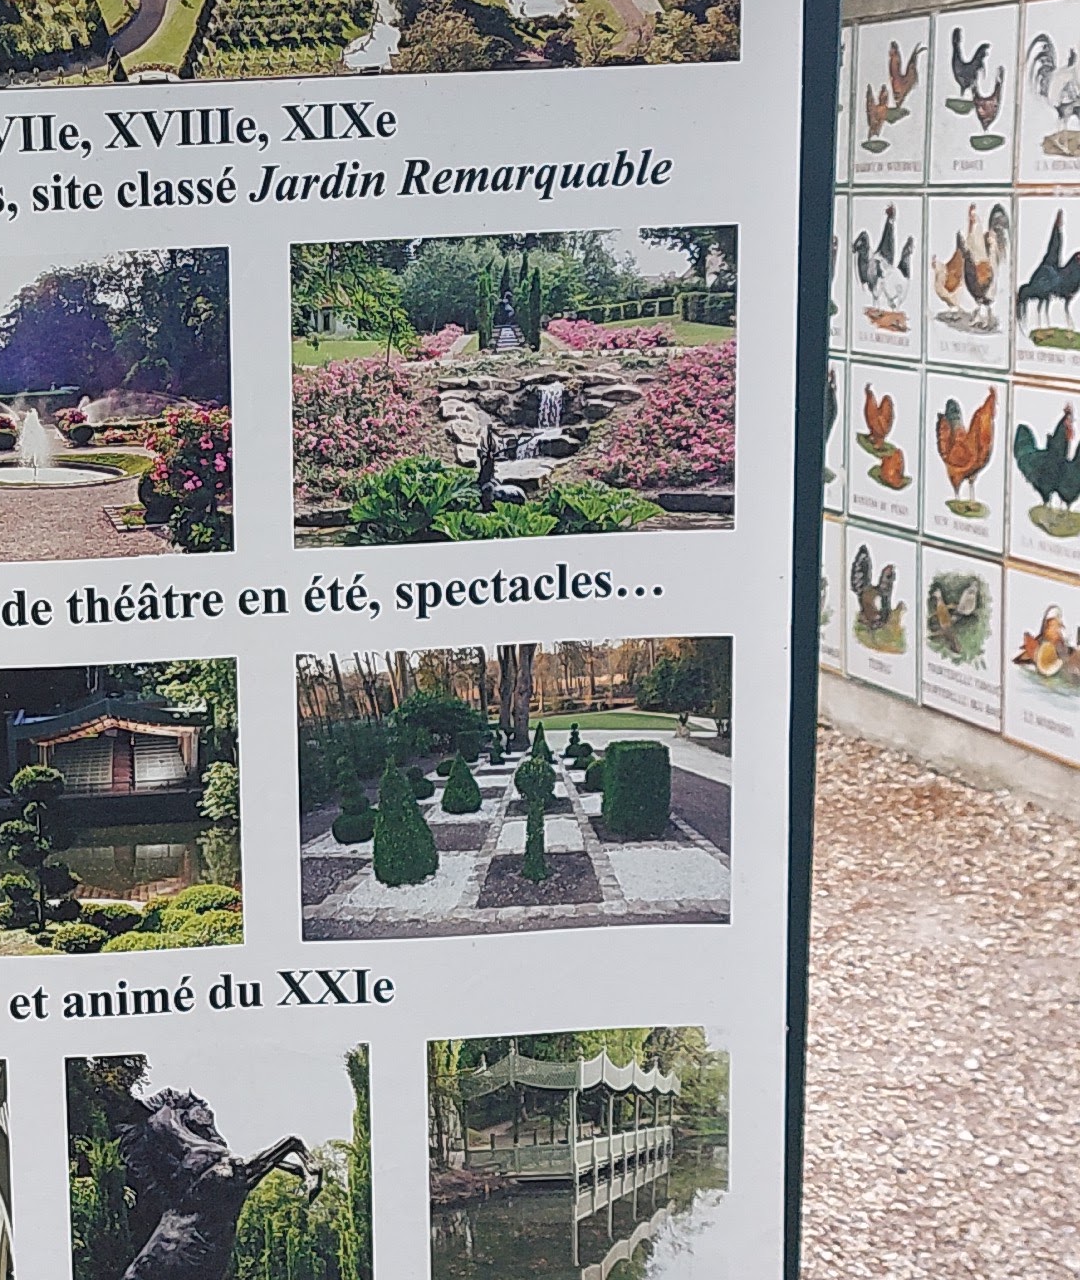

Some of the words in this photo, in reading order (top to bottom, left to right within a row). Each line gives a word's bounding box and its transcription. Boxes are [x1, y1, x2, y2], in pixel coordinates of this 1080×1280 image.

[104, 107, 269, 152] XVIIIe,
[282, 101, 397, 142] XIXe
[32, 173, 103, 212] site
[117, 166, 237, 208] classé
[248, 161, 385, 203] Jardin
[396, 149, 673, 201] Remarquable
[1, 590, 52, 627] de
[66, 582, 224, 625] théâtre
[238, 587, 288, 616] en
[304, 573, 380, 619] été,
[395, 563, 663, 620] spectacles...
[9, 987, 49, 1020] et
[63, 975, 194, 1019] animé
[208, 973, 262, 1010] du
[277, 969, 394, 1006] XXIe
